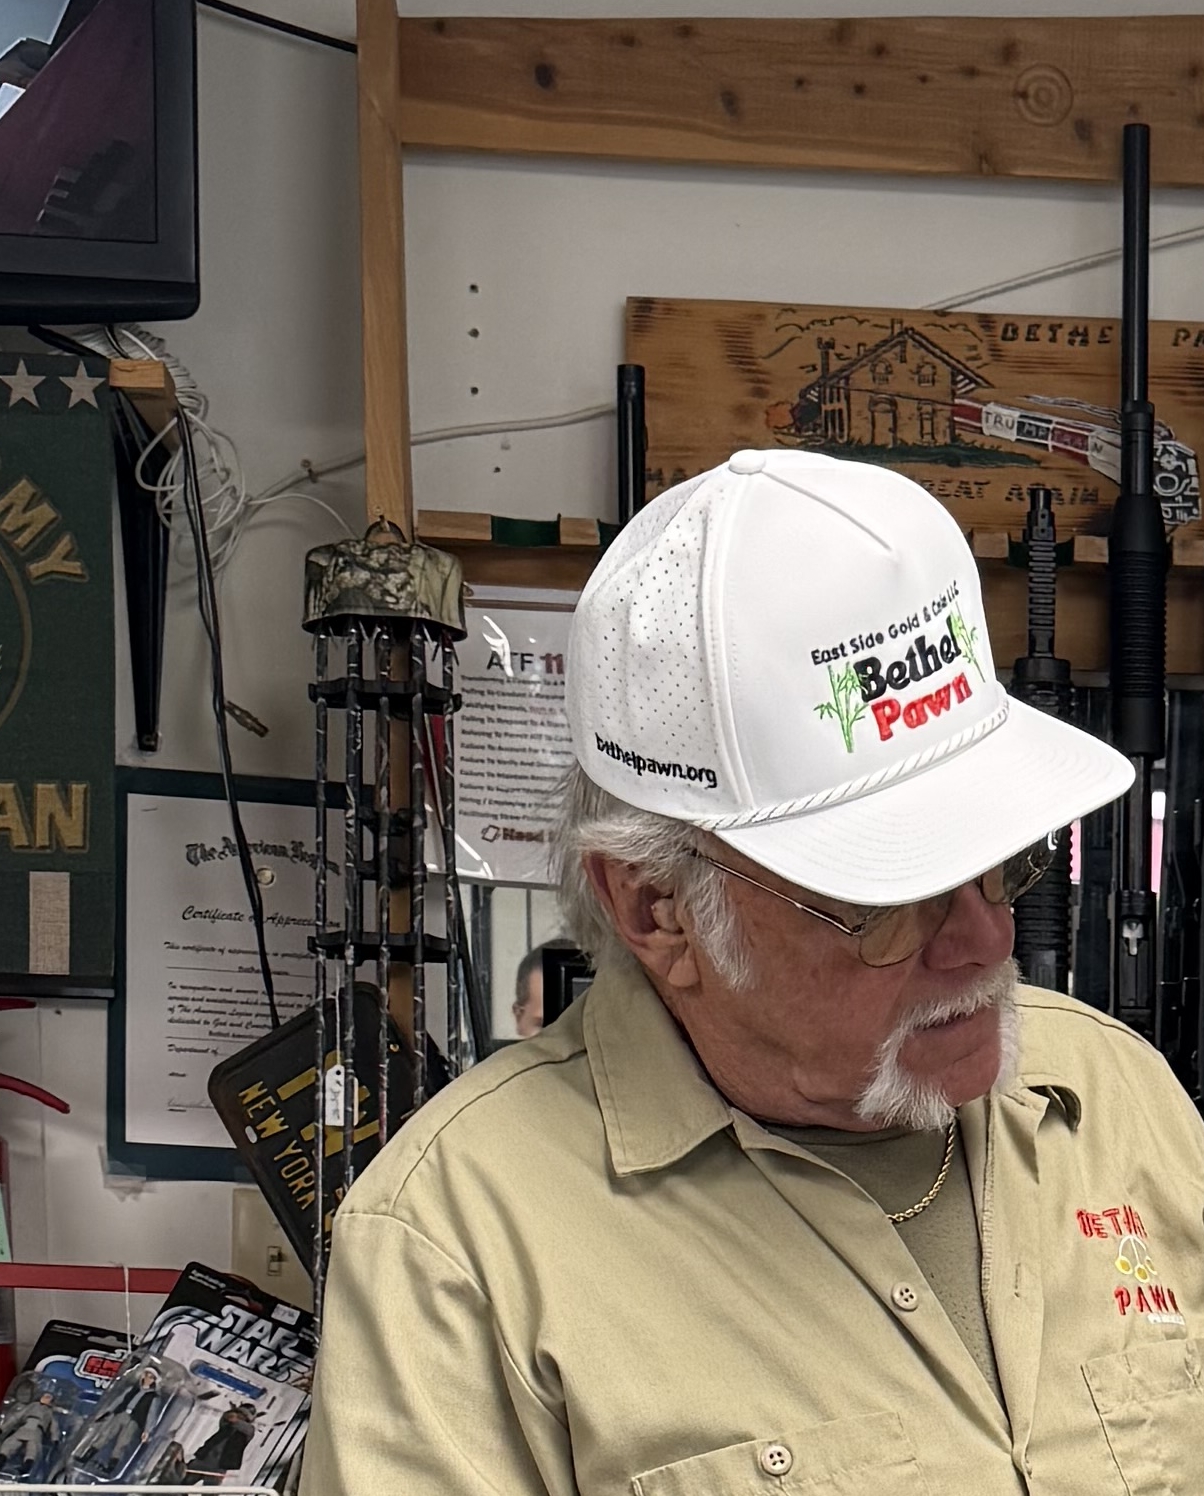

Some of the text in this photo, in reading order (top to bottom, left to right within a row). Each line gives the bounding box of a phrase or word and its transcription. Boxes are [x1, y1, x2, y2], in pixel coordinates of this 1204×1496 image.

[919, 479, 1099, 506] REAT AAIN
[811, 643, 847, 666] East
[852, 631, 884, 654] Side
[888, 613, 920, 639] Gold
[853, 615, 962, 703] Bethel
[871, 672, 973, 742] Pawn
[595, 732, 718, 790] bethelpawn.org
[182, 905, 244, 924] Certificate
[239, 1081, 289, 1139] NEW
[199, 1326, 311, 1382] WARS
[218, 1304, 314, 1366] STAR
